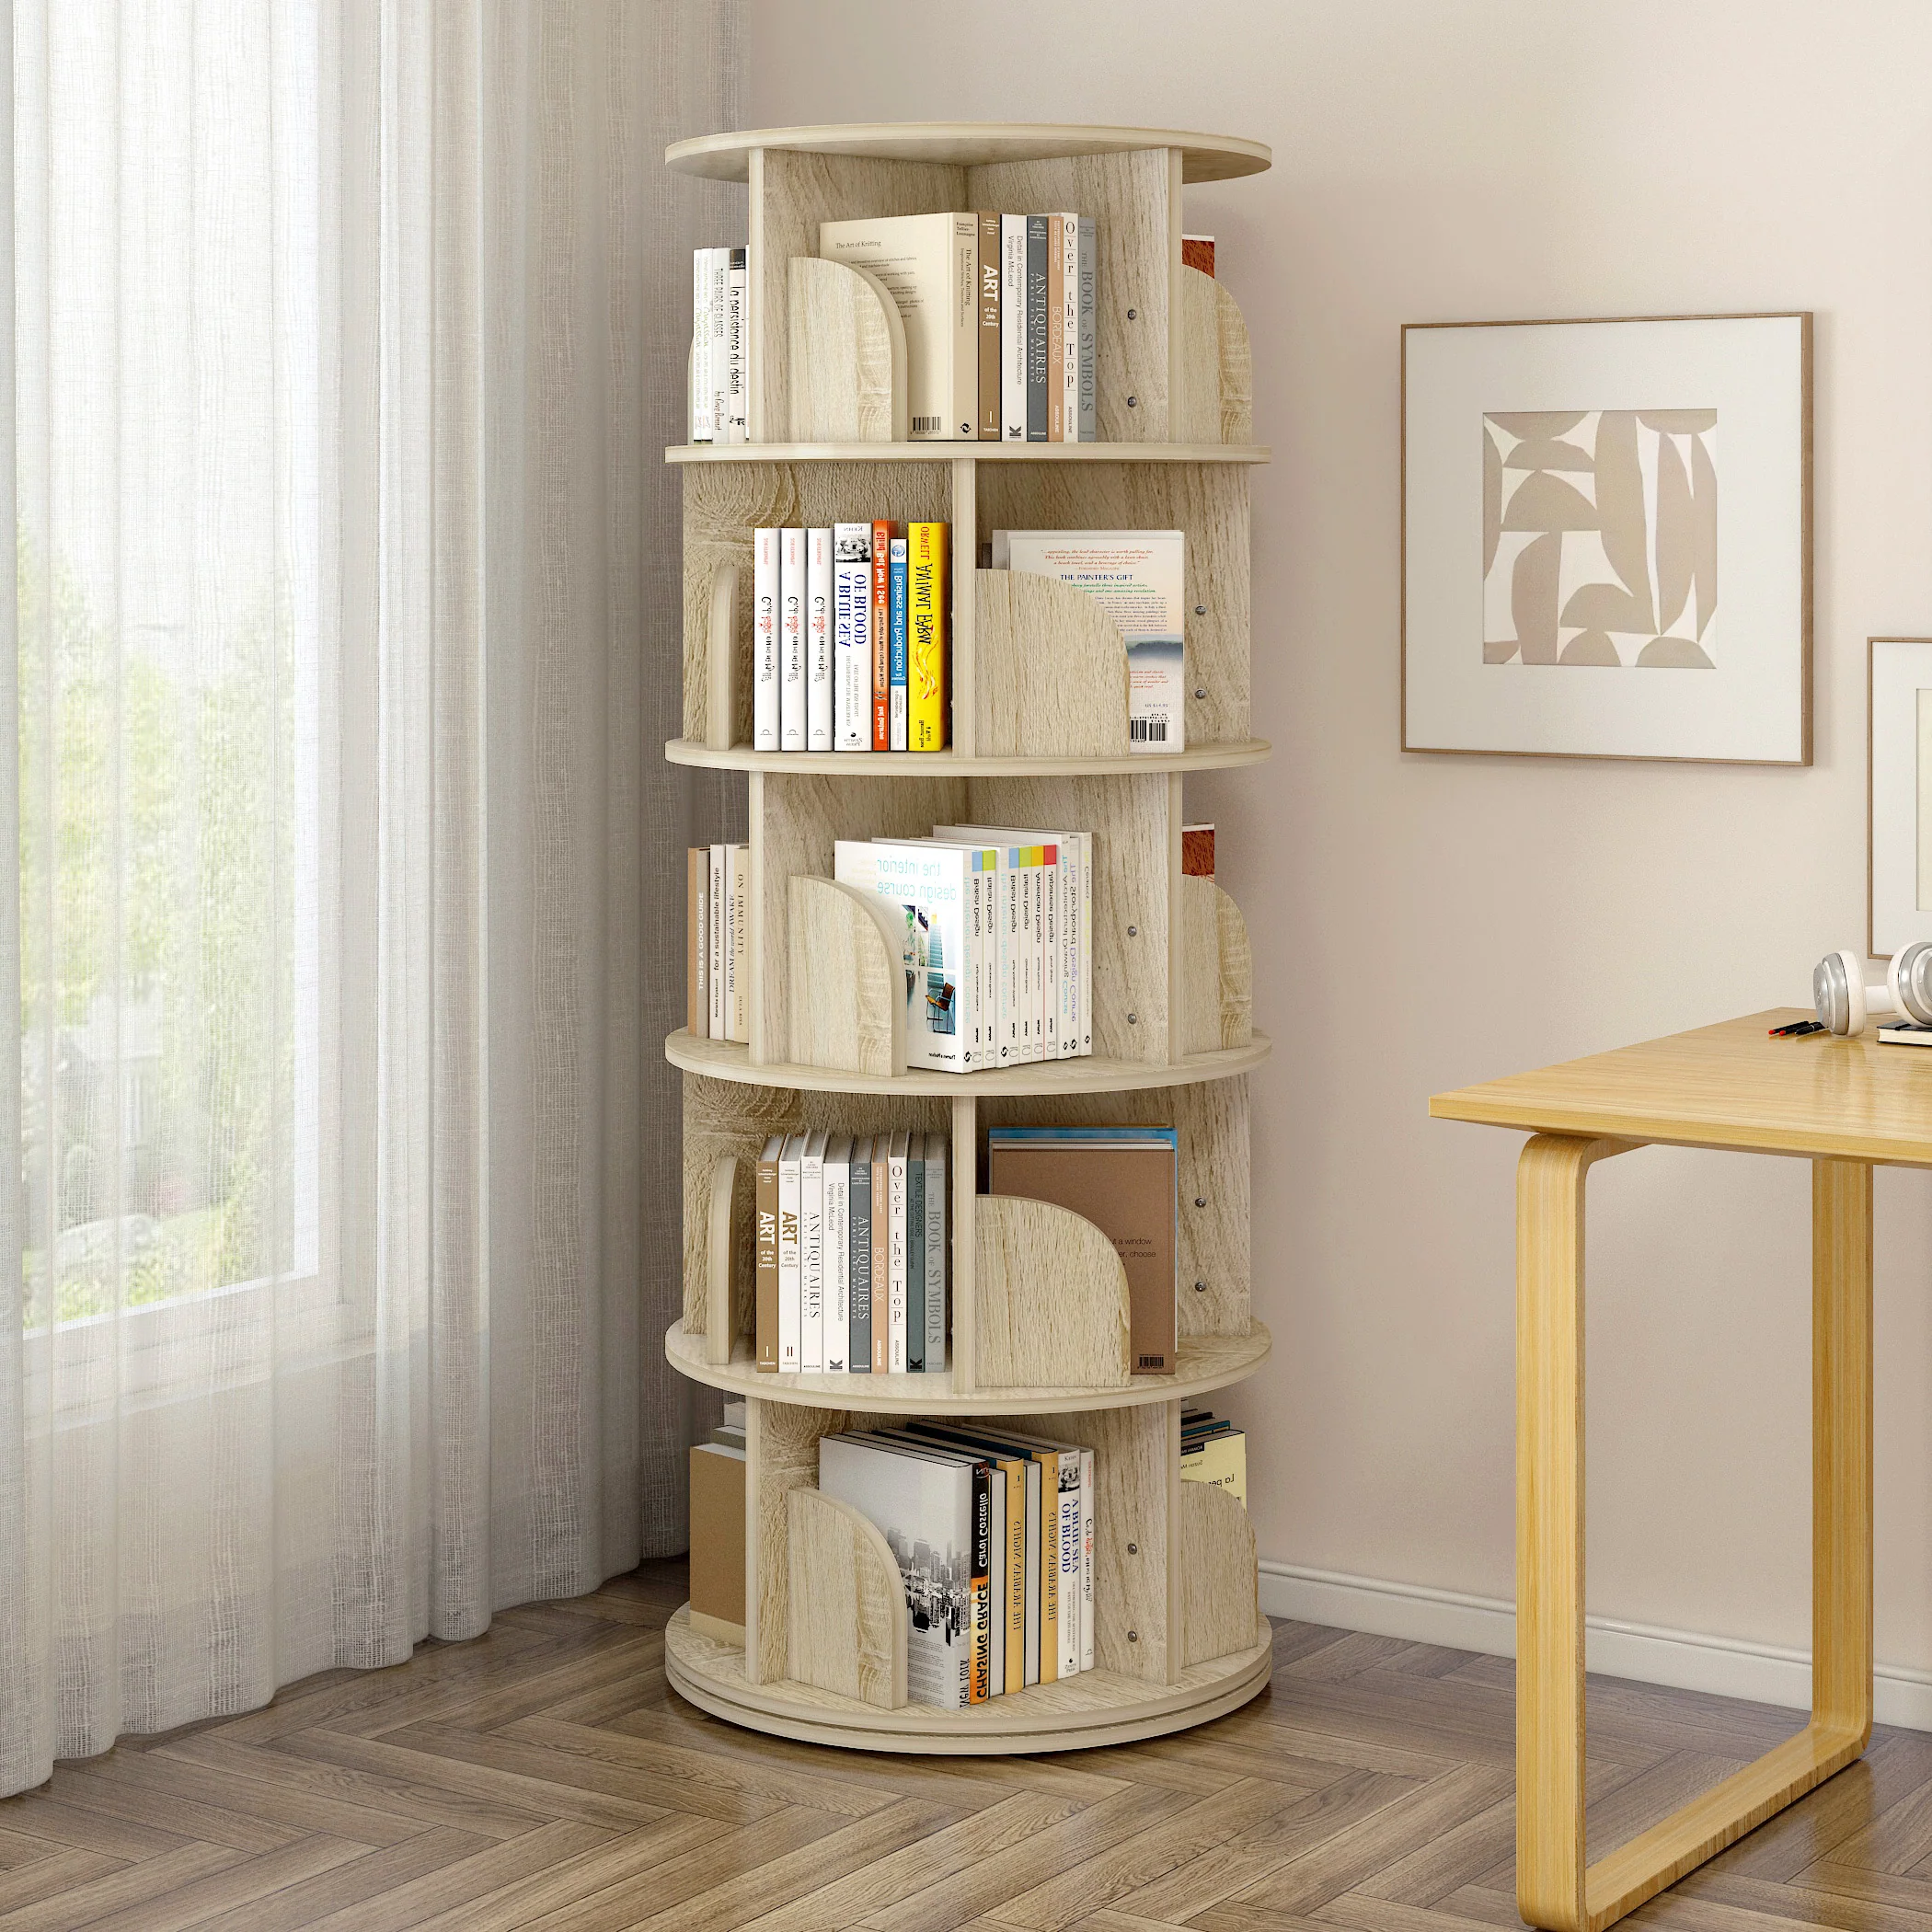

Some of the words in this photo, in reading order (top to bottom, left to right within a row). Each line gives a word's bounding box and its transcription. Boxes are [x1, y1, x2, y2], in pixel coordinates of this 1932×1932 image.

[714, 269, 723, 285] THREE
[714, 287, 723, 303] PAIRS
[730, 287, 745, 295] La
[983, 265, 998, 301] ART
[1015, 263, 1024, 308] Contemporary
[1082, 271, 1093, 316] BOOK
[714, 314, 723, 338] GLASSES
[730, 300, 743, 350] persistance
[1034, 273, 1046, 383] ANTIQUAIRES
[1052, 306, 1062, 364] BORDEAUX
[1082, 319, 1087, 329] OF
[730, 354, 745, 364] du
[1082, 333, 1093, 411] SYMBOLS
[730, 369, 743, 394] destin
[738, 874, 743, 889] ON
[760, 1212, 775, 1244] ART
[782, 1212, 797, 1244] ART
[836, 1208, 845, 1249] Contemporary
[914, 1201, 923, 1237] DESIGNERS
[928, 1211, 941, 1252] BOOK
[808, 1213, 820, 1318] ANTIQUAIRES
[857, 1216, 869, 1319] ANTIQUAIRES
[874, 1248, 884, 1301] BORDEAUX
[928, 1257, 934, 1266] OF
[928, 1271, 941, 1344] SYMBOLS
[1062, 1503, 1071, 1521] OF
[1062, 1525, 1071, 1572] BLOOD
